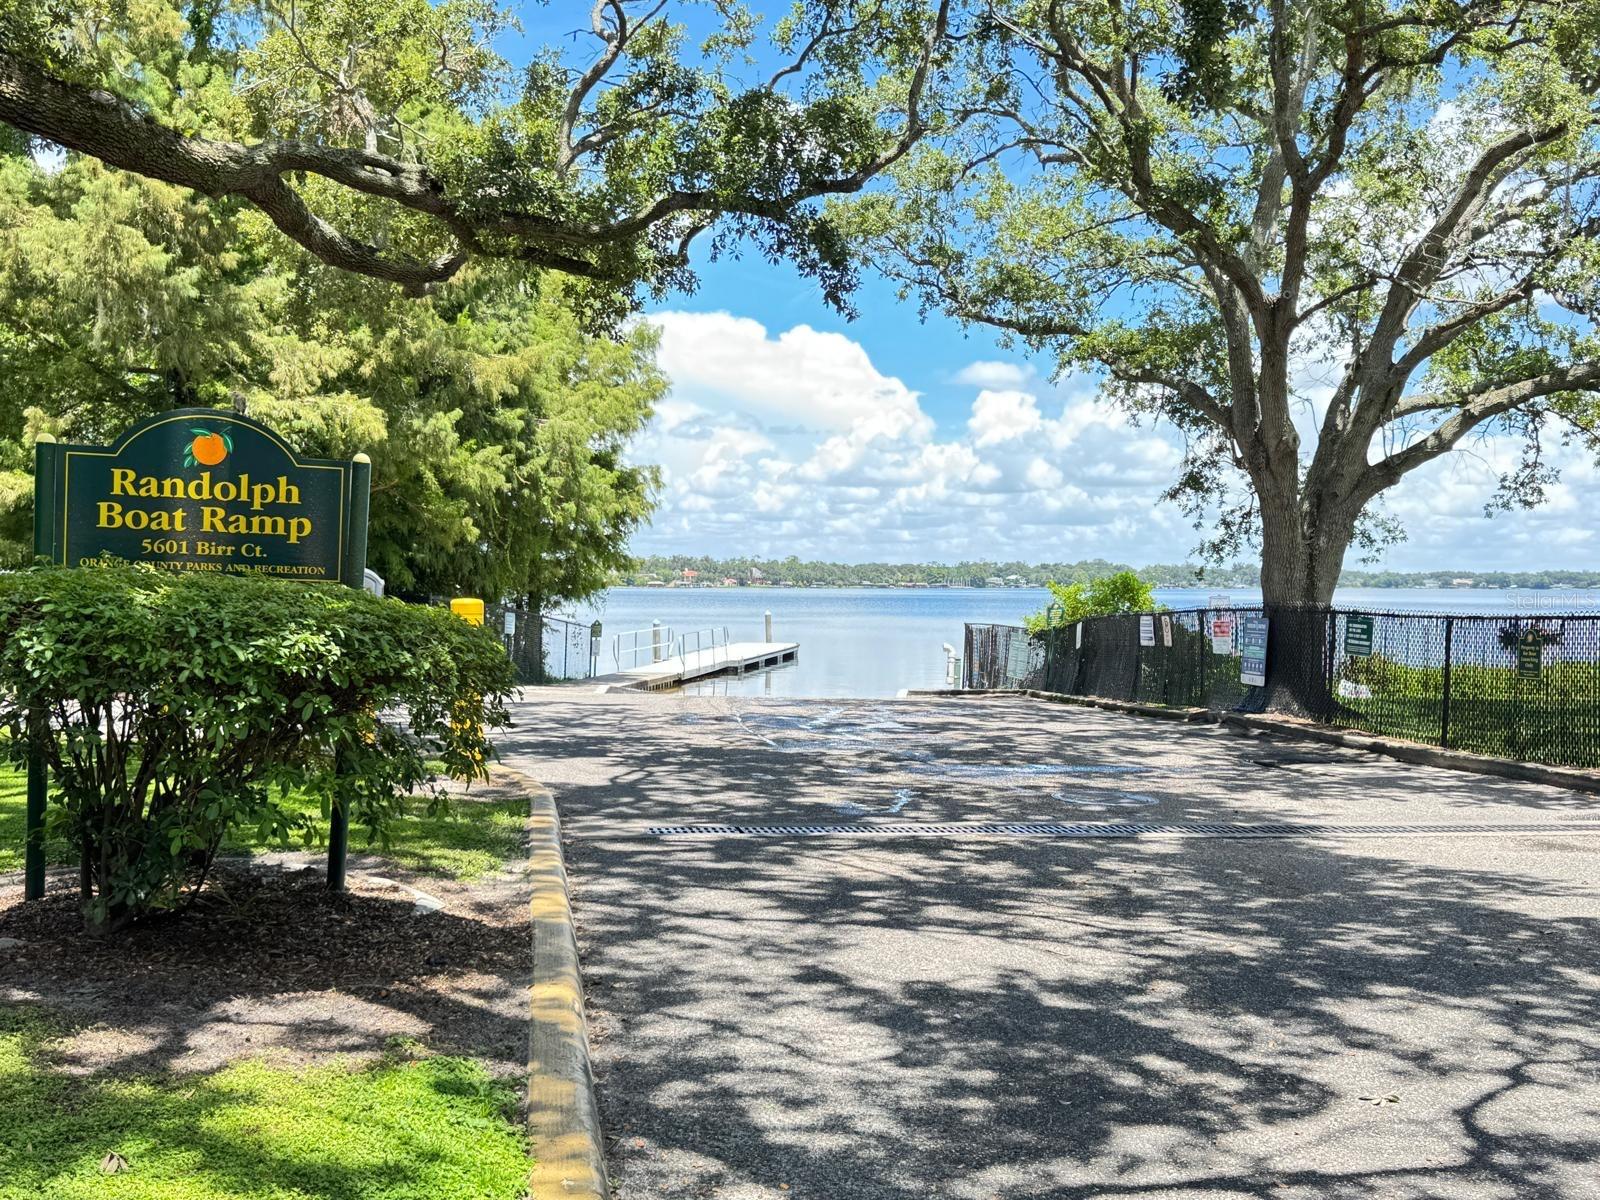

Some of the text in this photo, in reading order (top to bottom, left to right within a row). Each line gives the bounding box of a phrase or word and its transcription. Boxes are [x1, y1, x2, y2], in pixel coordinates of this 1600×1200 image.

[110, 468, 301, 511] Randolph
[96, 501, 312, 544] Boat Ramp
[141, 538, 268, 558] 5601 Birr Ct.
[186, 561, 222, 572] PARKS
[225, 563, 251, 573] AND
[254, 564, 326, 575] RECREATION
